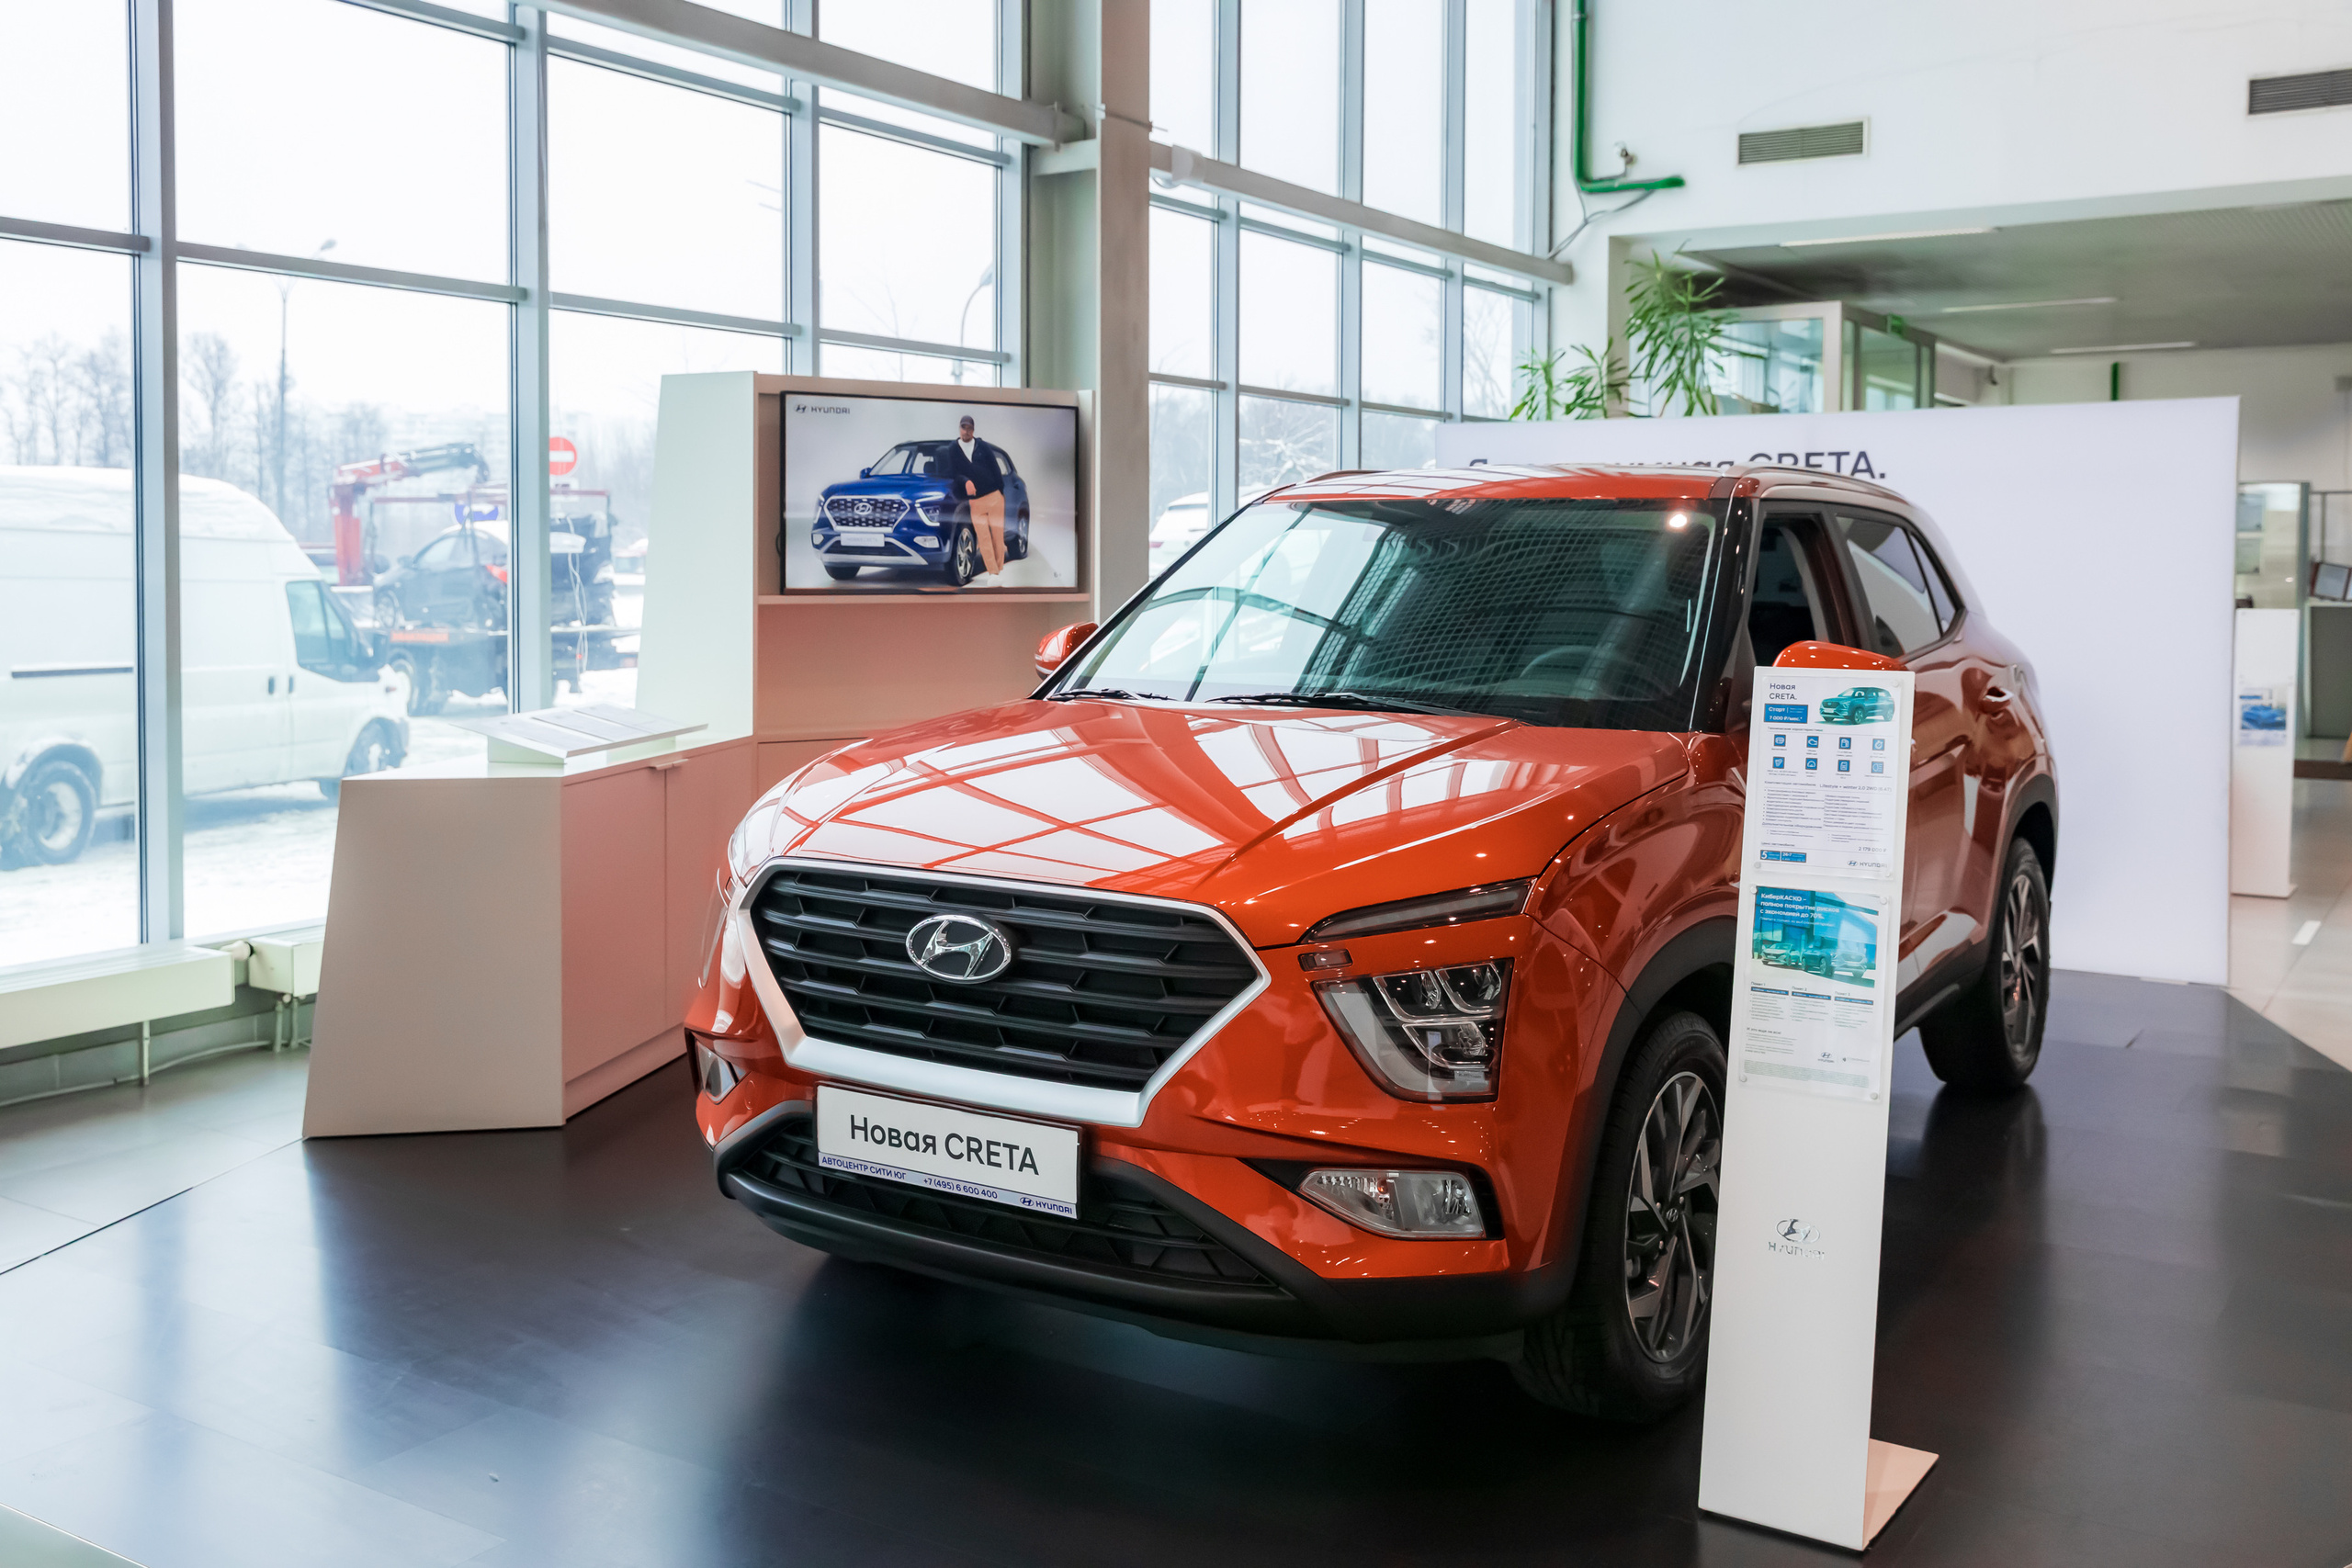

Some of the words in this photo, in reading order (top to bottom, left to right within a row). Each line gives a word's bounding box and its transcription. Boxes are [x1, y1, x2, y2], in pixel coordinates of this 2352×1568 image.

[811, 406, 851, 414] HYUNDAI
[1761, 851, 1768, 860] 5
[1760, 893, 1802, 902] КиберКАСКО
[850, 1114, 937, 1156] Новая
[944, 1133, 1040, 1176] CRETA
[821, 1156, 869, 1174] АВТОЦЕНТР
[869, 1166, 893, 1178] СИТИ
[894, 1171, 907, 1180] ЮГ
[923, 1178, 933, 1186] +7
[933, 1179, 956, 1191] (495)
[956, 1183, 962, 1192] 6
[963, 1185, 980, 1196] 600
[980, 1189, 998, 1200] 400
[1035, 1201, 1073, 1215] HYUNDAI
